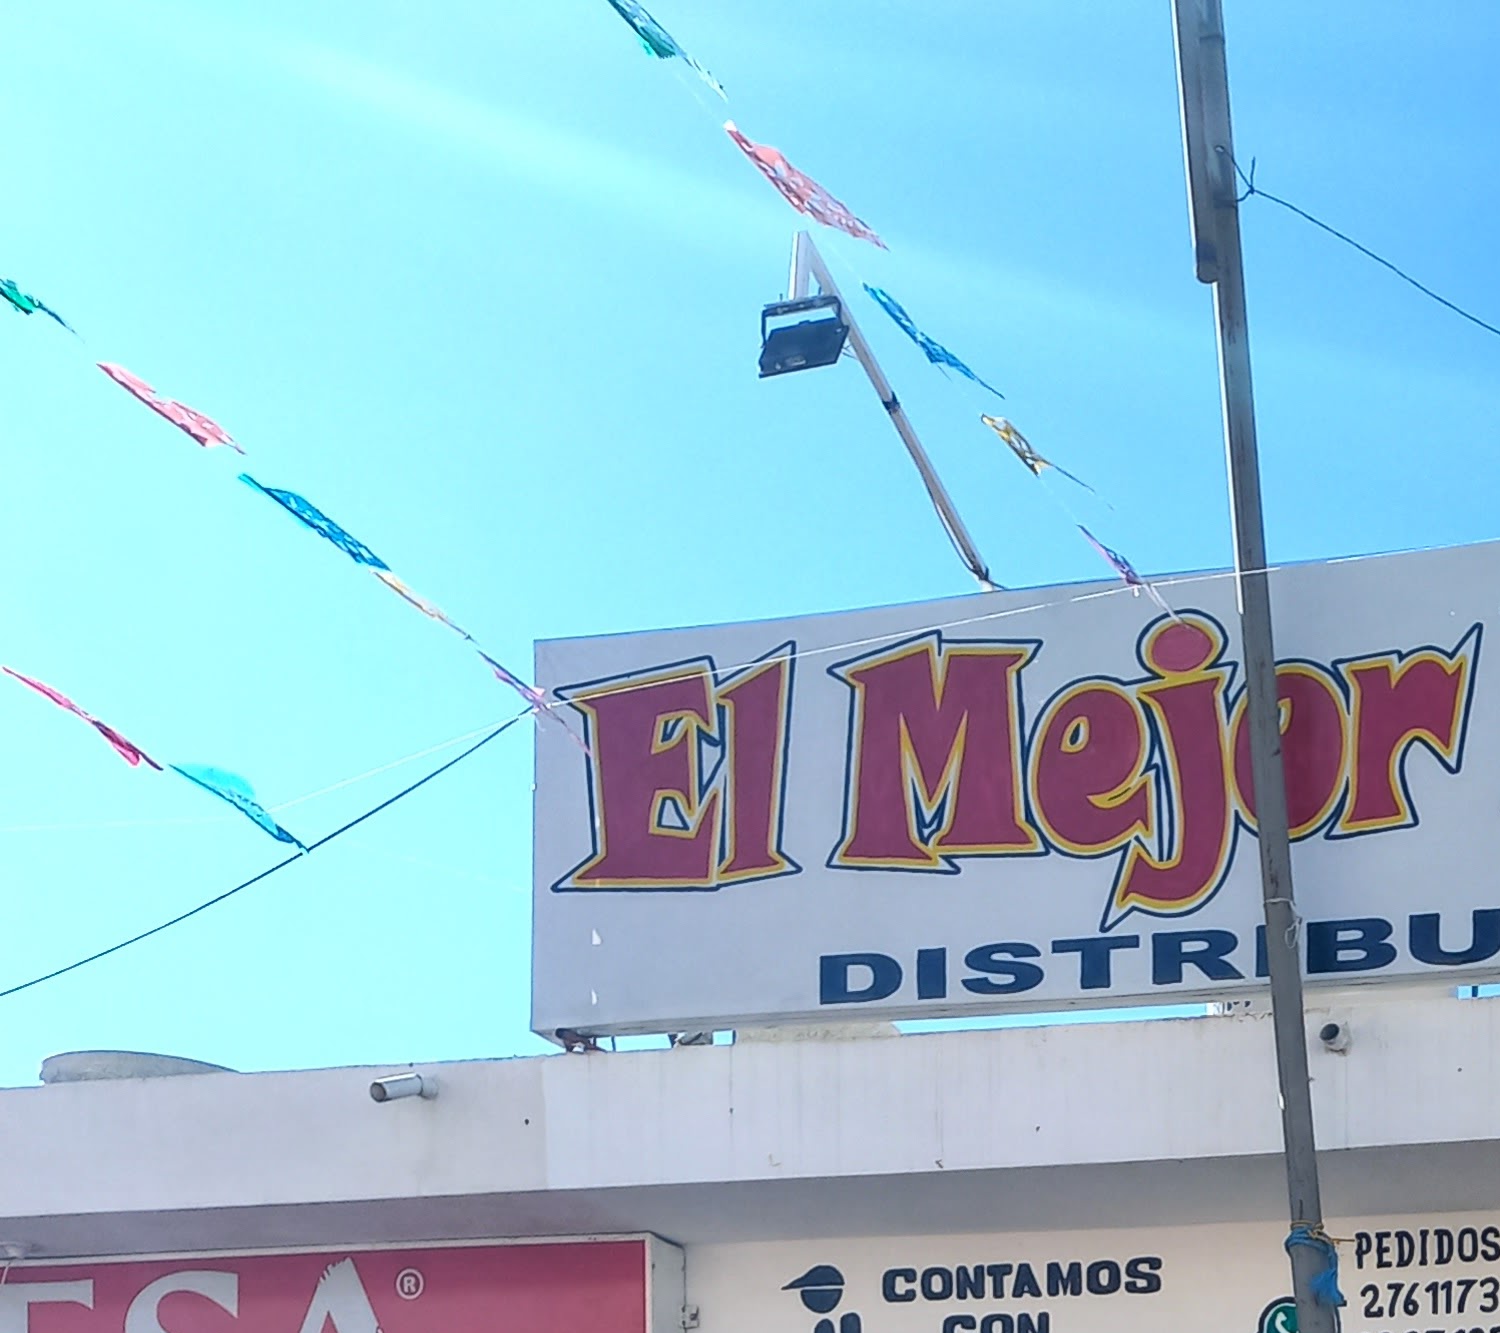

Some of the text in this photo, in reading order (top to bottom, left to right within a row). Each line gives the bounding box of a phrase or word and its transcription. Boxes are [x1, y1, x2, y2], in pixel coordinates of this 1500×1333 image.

[551, 641, 802, 892] El
[826, 608, 1483, 932] Mejor
[1354, 1226, 1500, 1269] PEDIDOS
[882, 1256, 1163, 1302] CONTAMOS
